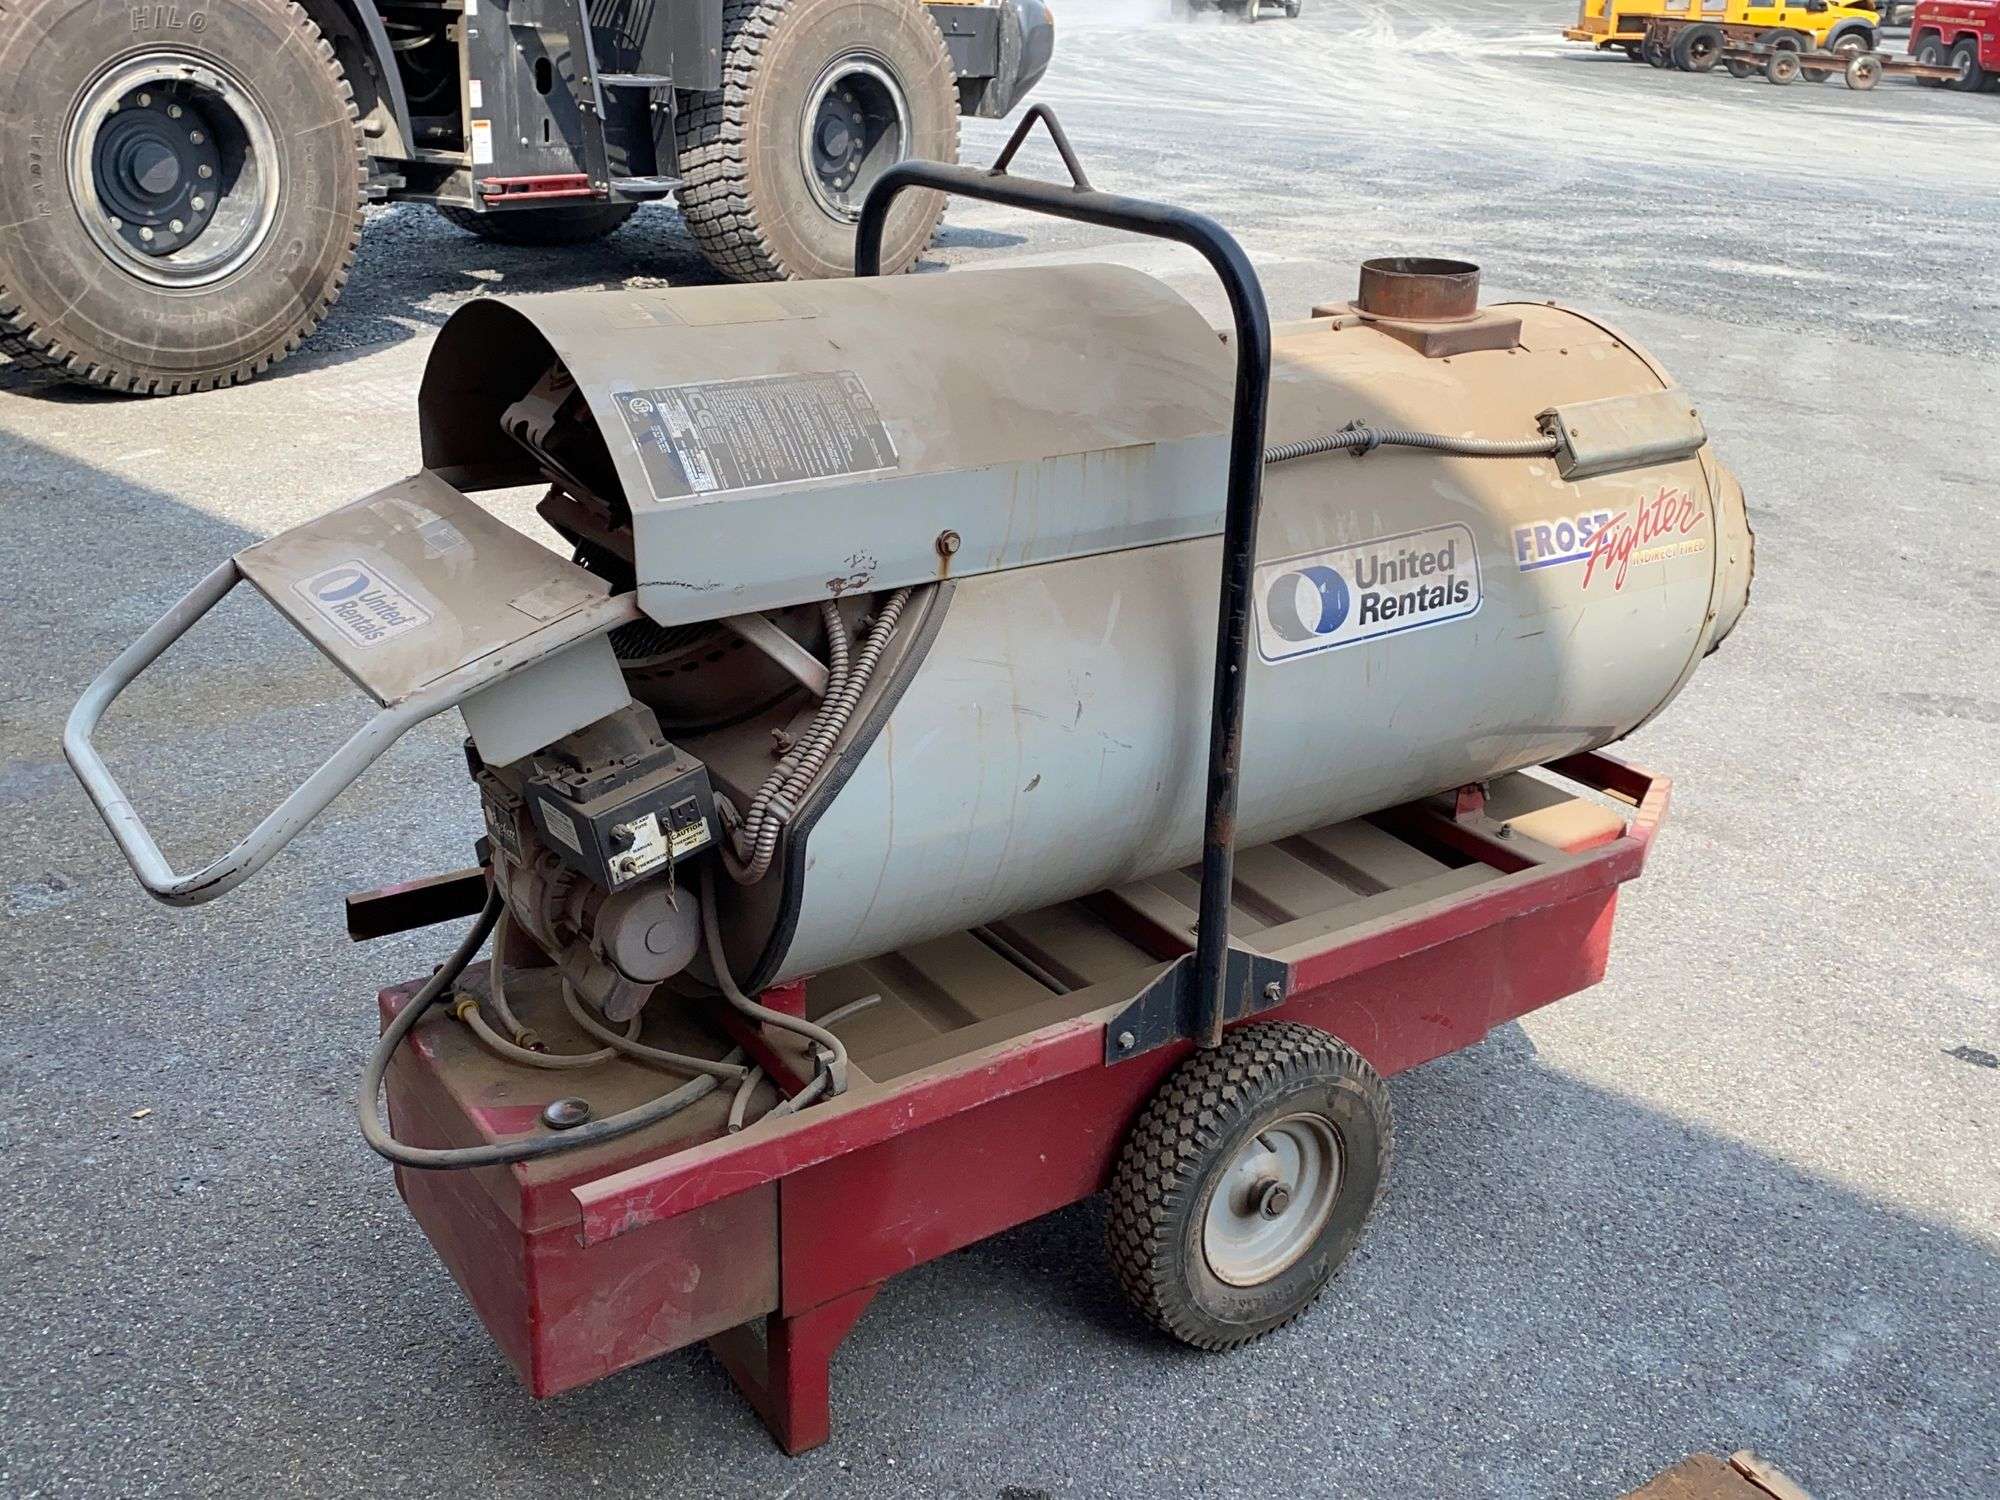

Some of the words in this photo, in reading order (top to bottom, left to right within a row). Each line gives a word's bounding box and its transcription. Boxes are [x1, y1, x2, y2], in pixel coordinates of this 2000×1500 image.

[130, 5, 208, 33] HILO
[1514, 513, 1609, 562] FROST
[1582, 487, 1705, 590] Fighter
[1355, 539, 1455, 589] United
[359, 590, 416, 626] United
[1359, 574, 1469, 625] Rentals
[331, 600, 385, 640] Rentals
[671, 821, 703, 840] CAUTION
